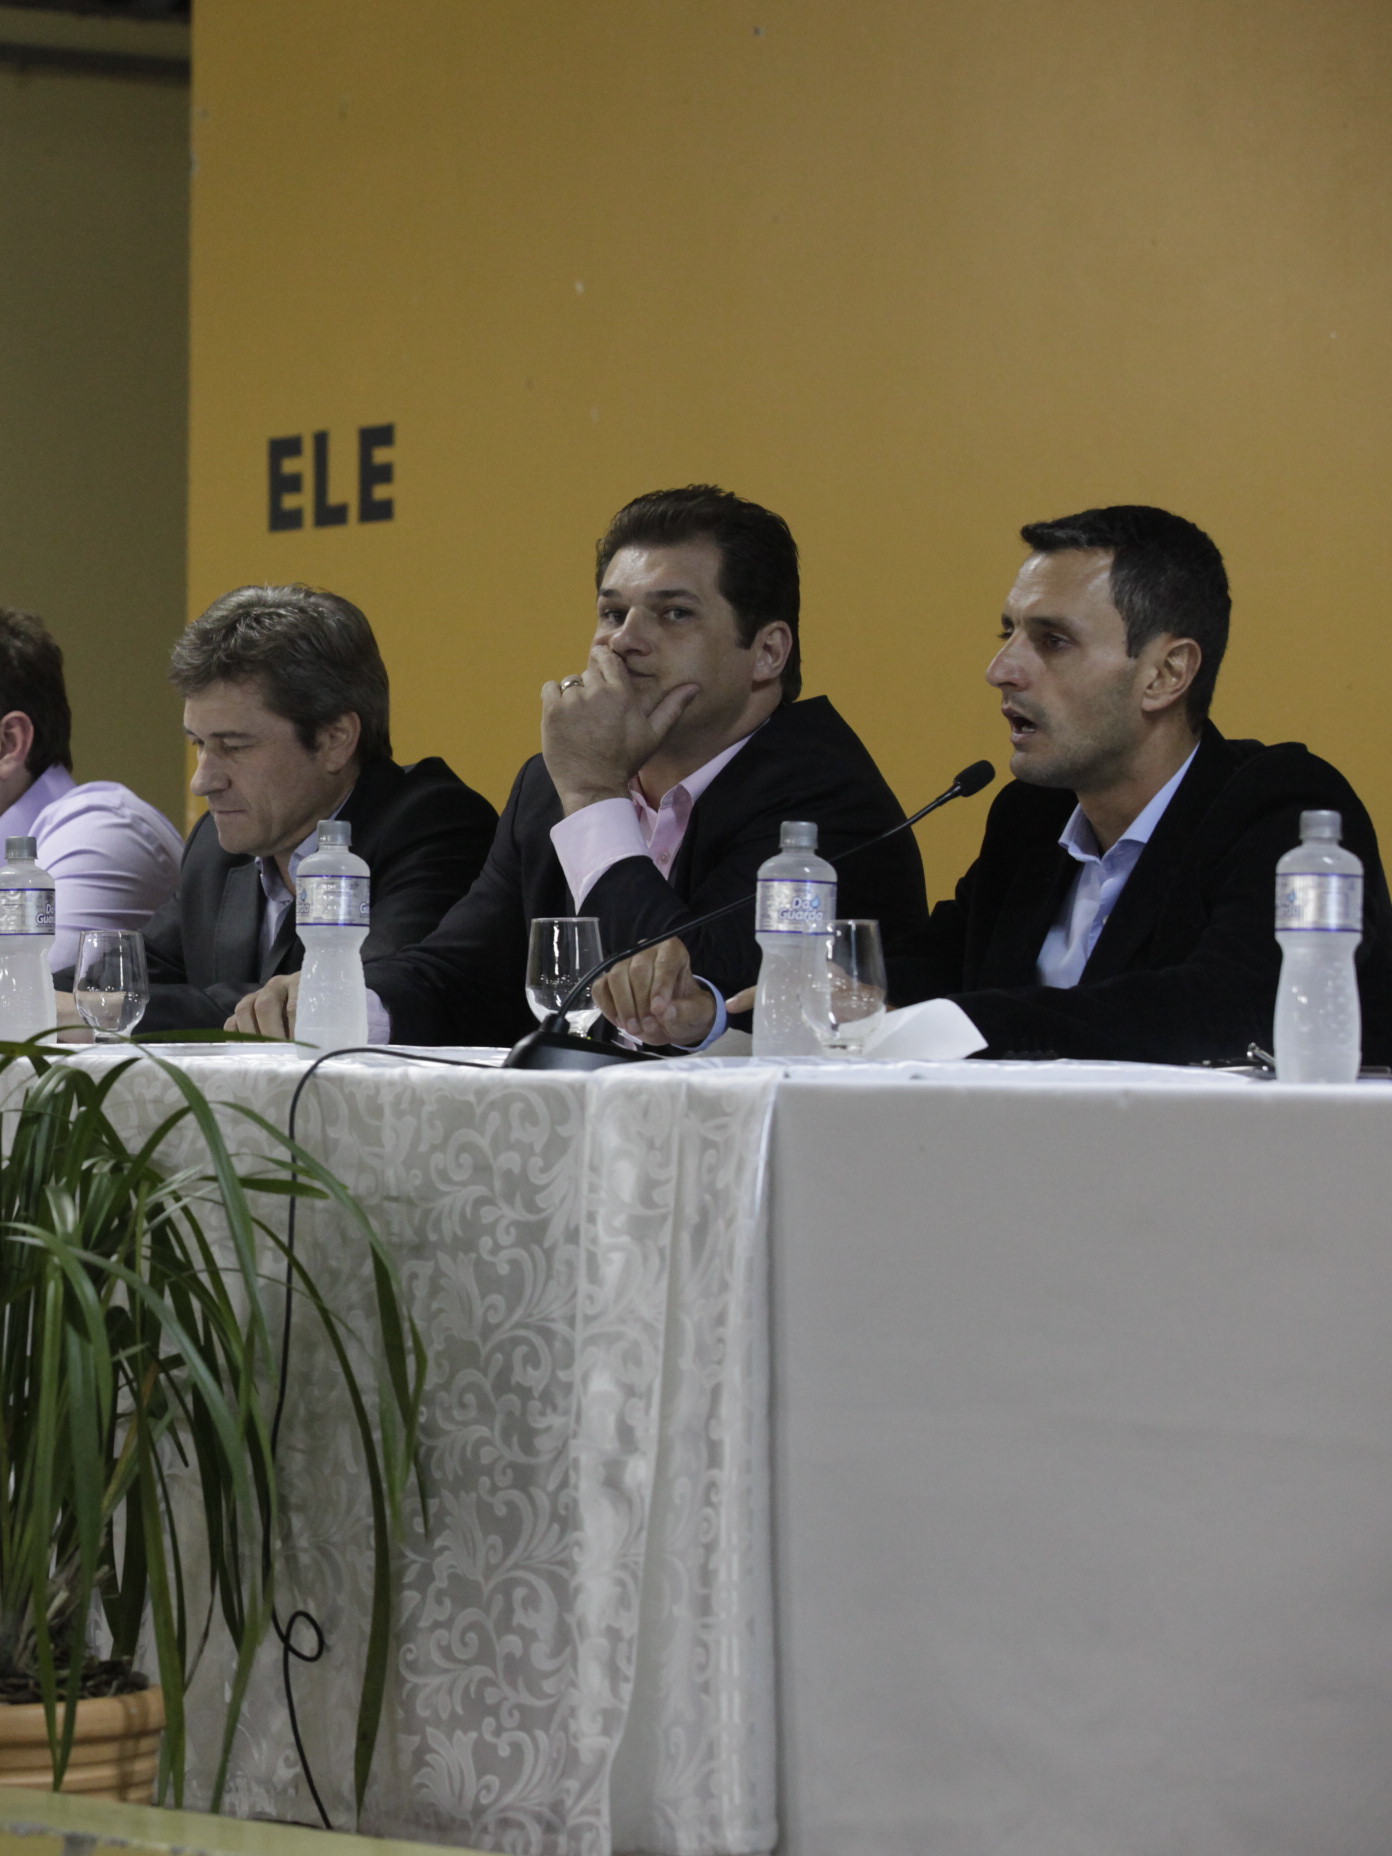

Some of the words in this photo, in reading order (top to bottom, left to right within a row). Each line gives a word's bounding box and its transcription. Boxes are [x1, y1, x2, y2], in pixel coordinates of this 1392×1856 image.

[267, 422, 395, 533] ELE
[792, 897, 812, 910] Da
[779, 908, 823, 920] Guarda
